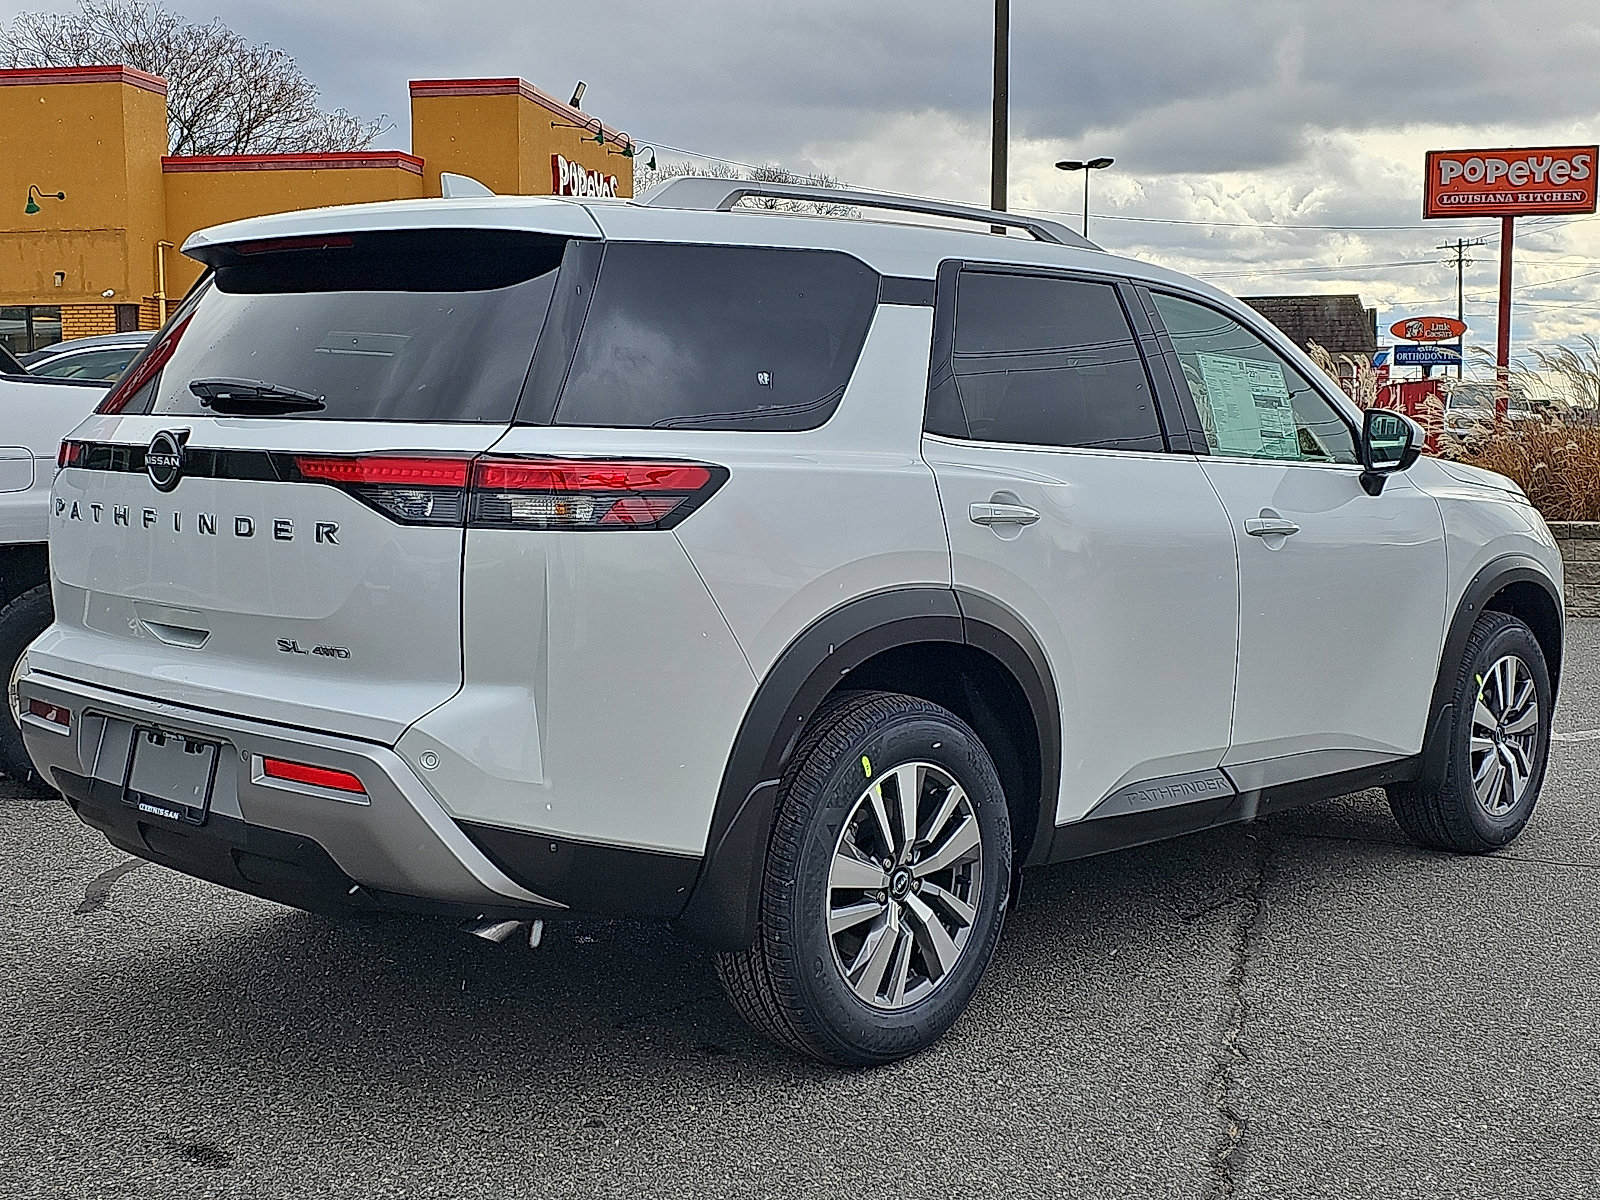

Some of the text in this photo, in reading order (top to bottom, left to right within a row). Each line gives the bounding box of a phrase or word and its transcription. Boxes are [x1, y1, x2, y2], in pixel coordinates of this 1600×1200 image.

[1442, 192, 1583, 204] LOUISIANA KITCHEN
[1430, 322, 1451, 331] Little
[1425, 330, 1453, 338] Caesars
[145, 455, 180, 467] NISSAN
[55, 497, 341, 545] PATHFINDER
[276, 638, 352, 660] SL 4WD
[1124, 777, 1229, 805] PATHFINDER
